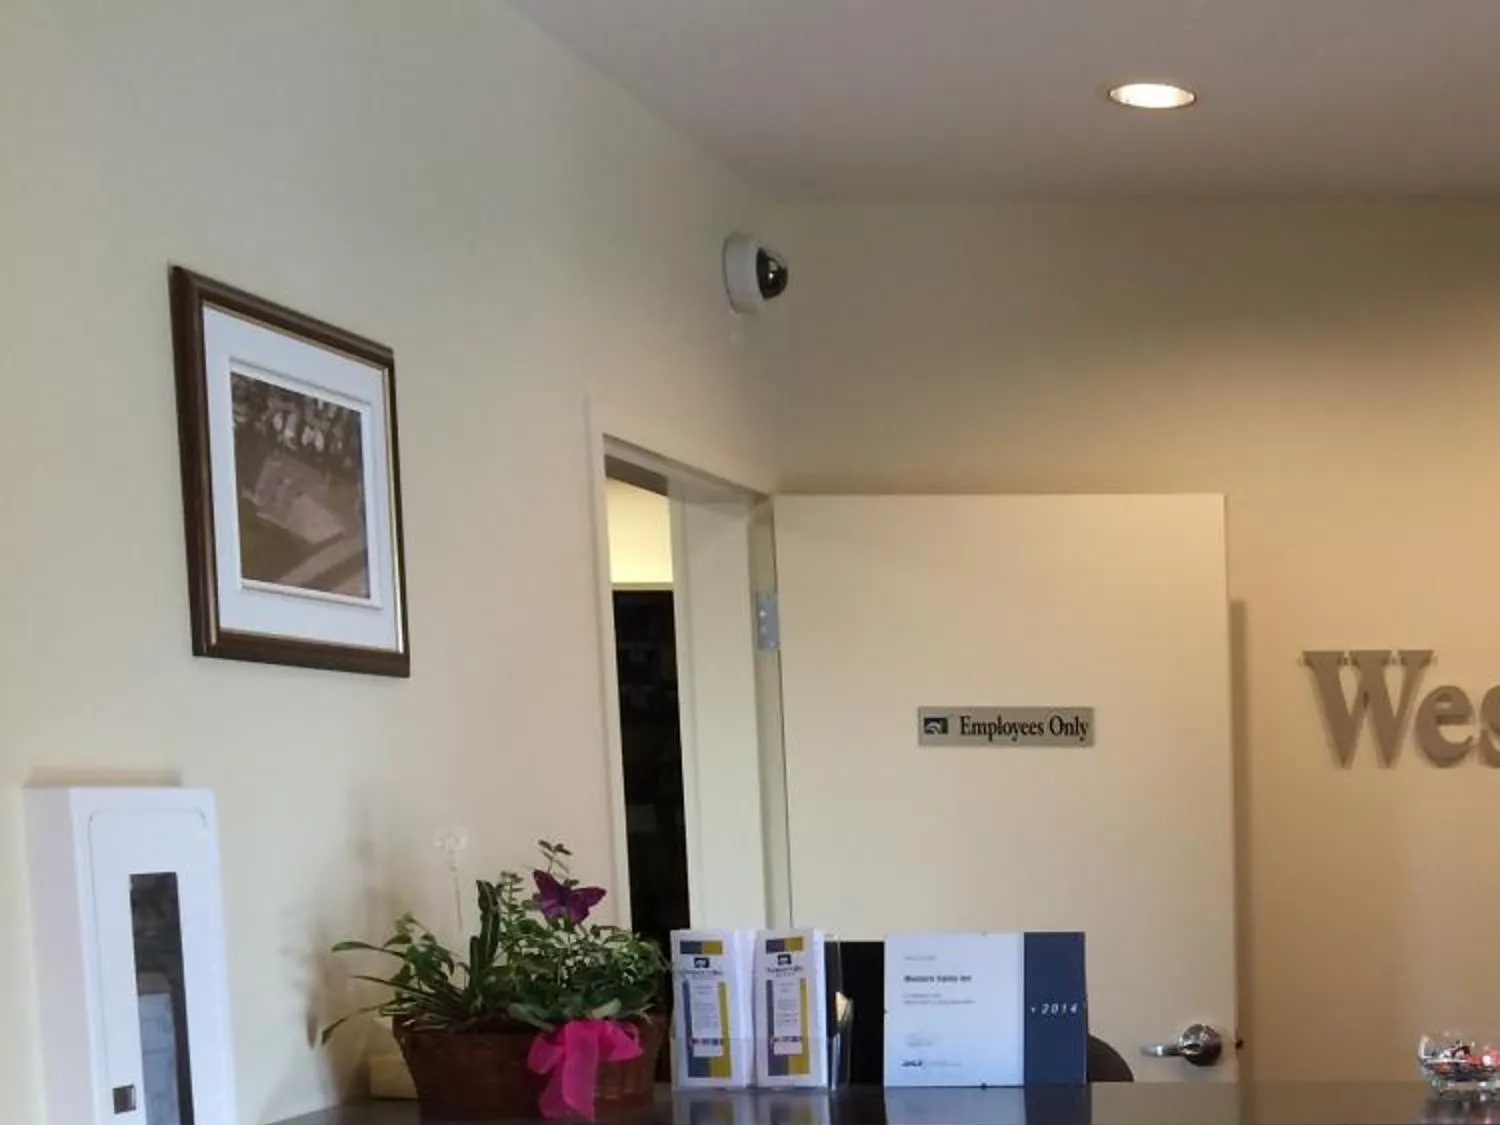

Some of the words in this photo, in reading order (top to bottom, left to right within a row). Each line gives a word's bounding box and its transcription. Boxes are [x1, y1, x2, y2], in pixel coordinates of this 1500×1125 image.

[959, 715, 1045, 742] Employees
[1049, 715, 1089, 742] Only
[1041, 1003, 1078, 1015] 2014
